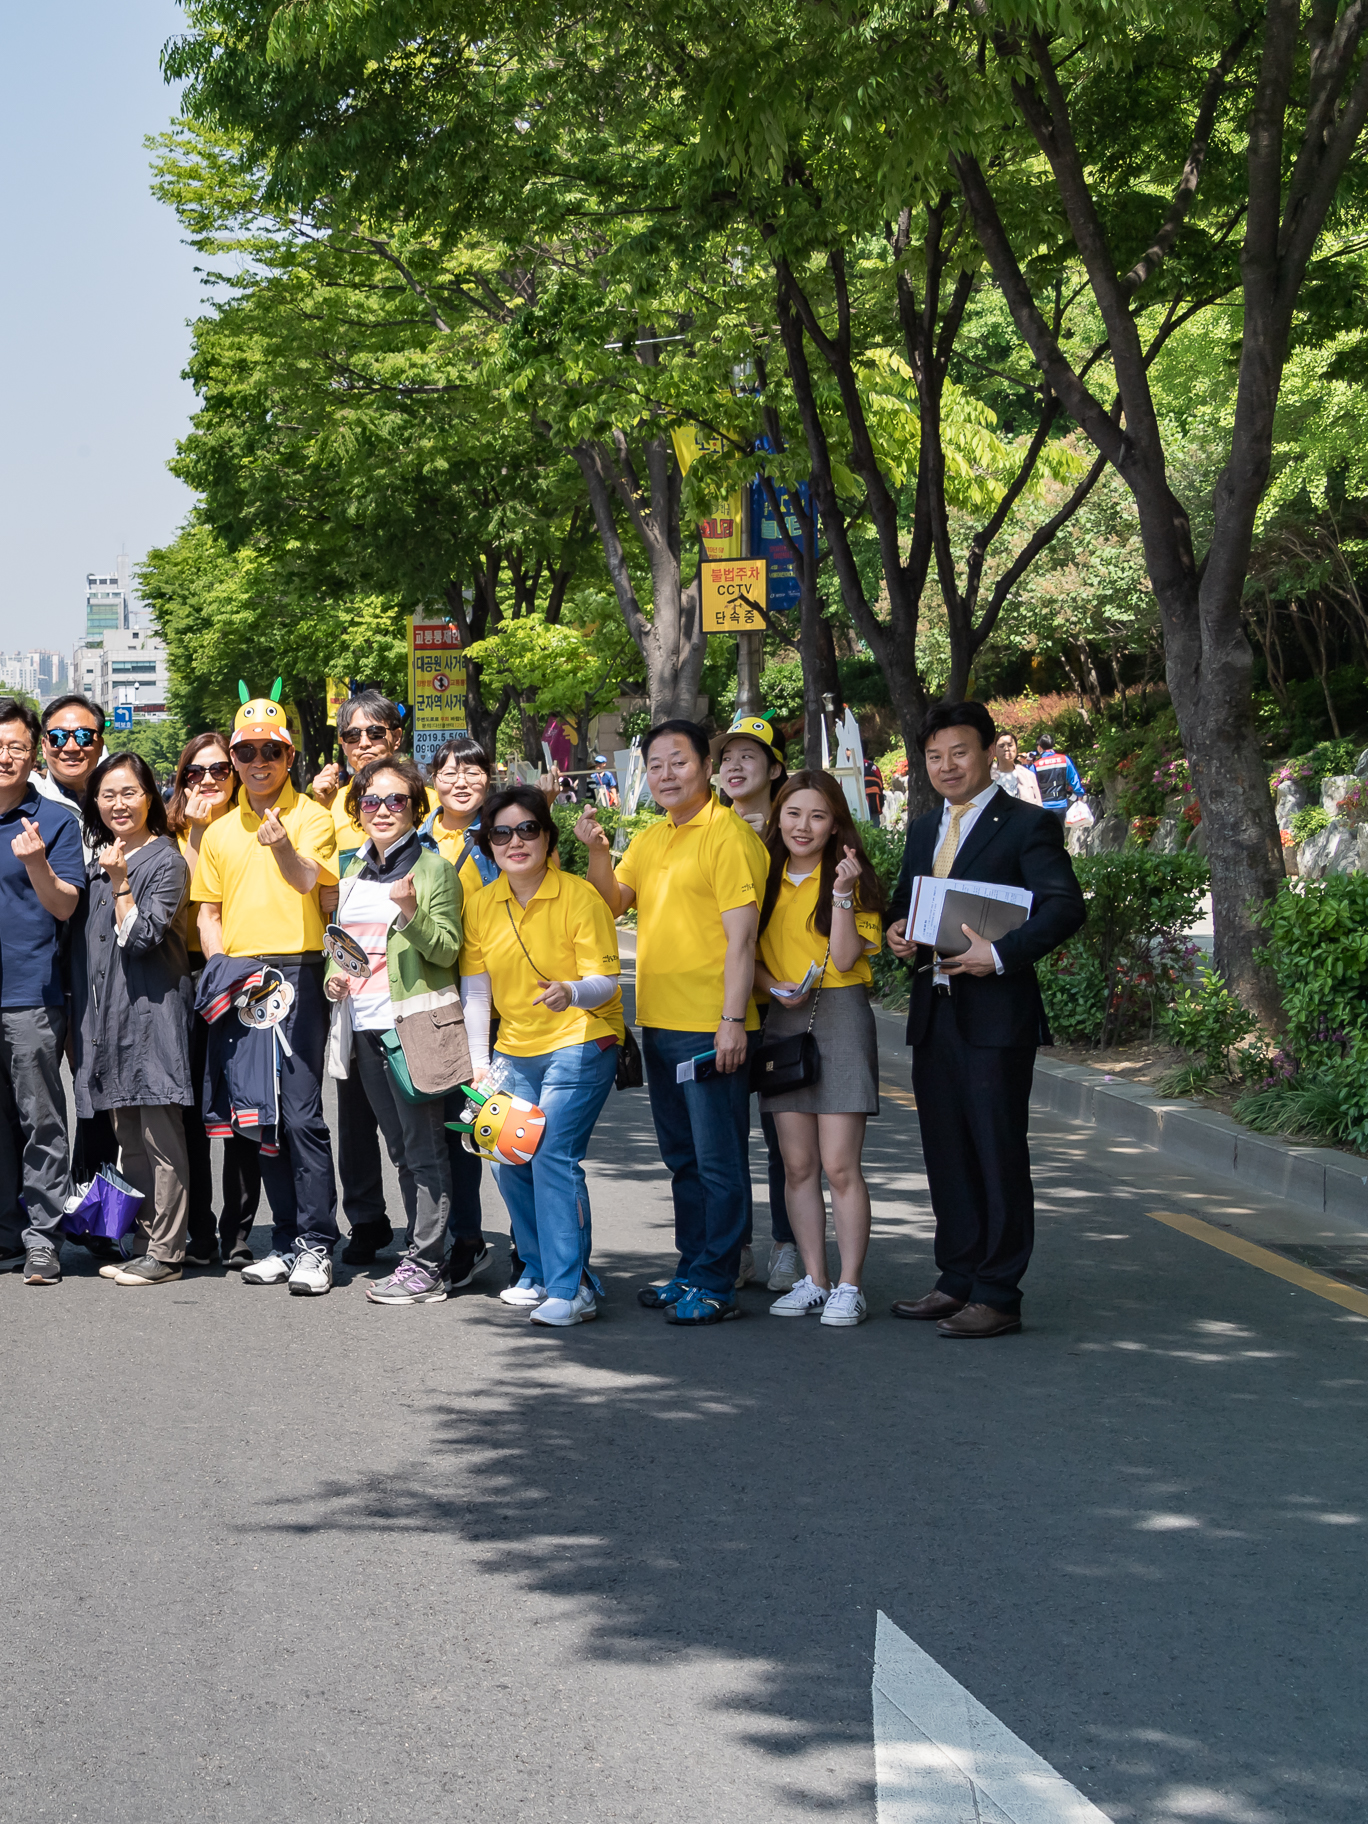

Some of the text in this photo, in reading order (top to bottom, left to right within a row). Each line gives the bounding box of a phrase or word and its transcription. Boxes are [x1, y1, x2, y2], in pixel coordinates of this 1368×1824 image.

[711, 566, 760, 583] 불법주차
[717, 584, 752, 596] CCTV
[415, 629, 461, 645] 교통통제안
[416, 655, 442, 673] 대공원
[416, 693, 442, 711] 군자역
